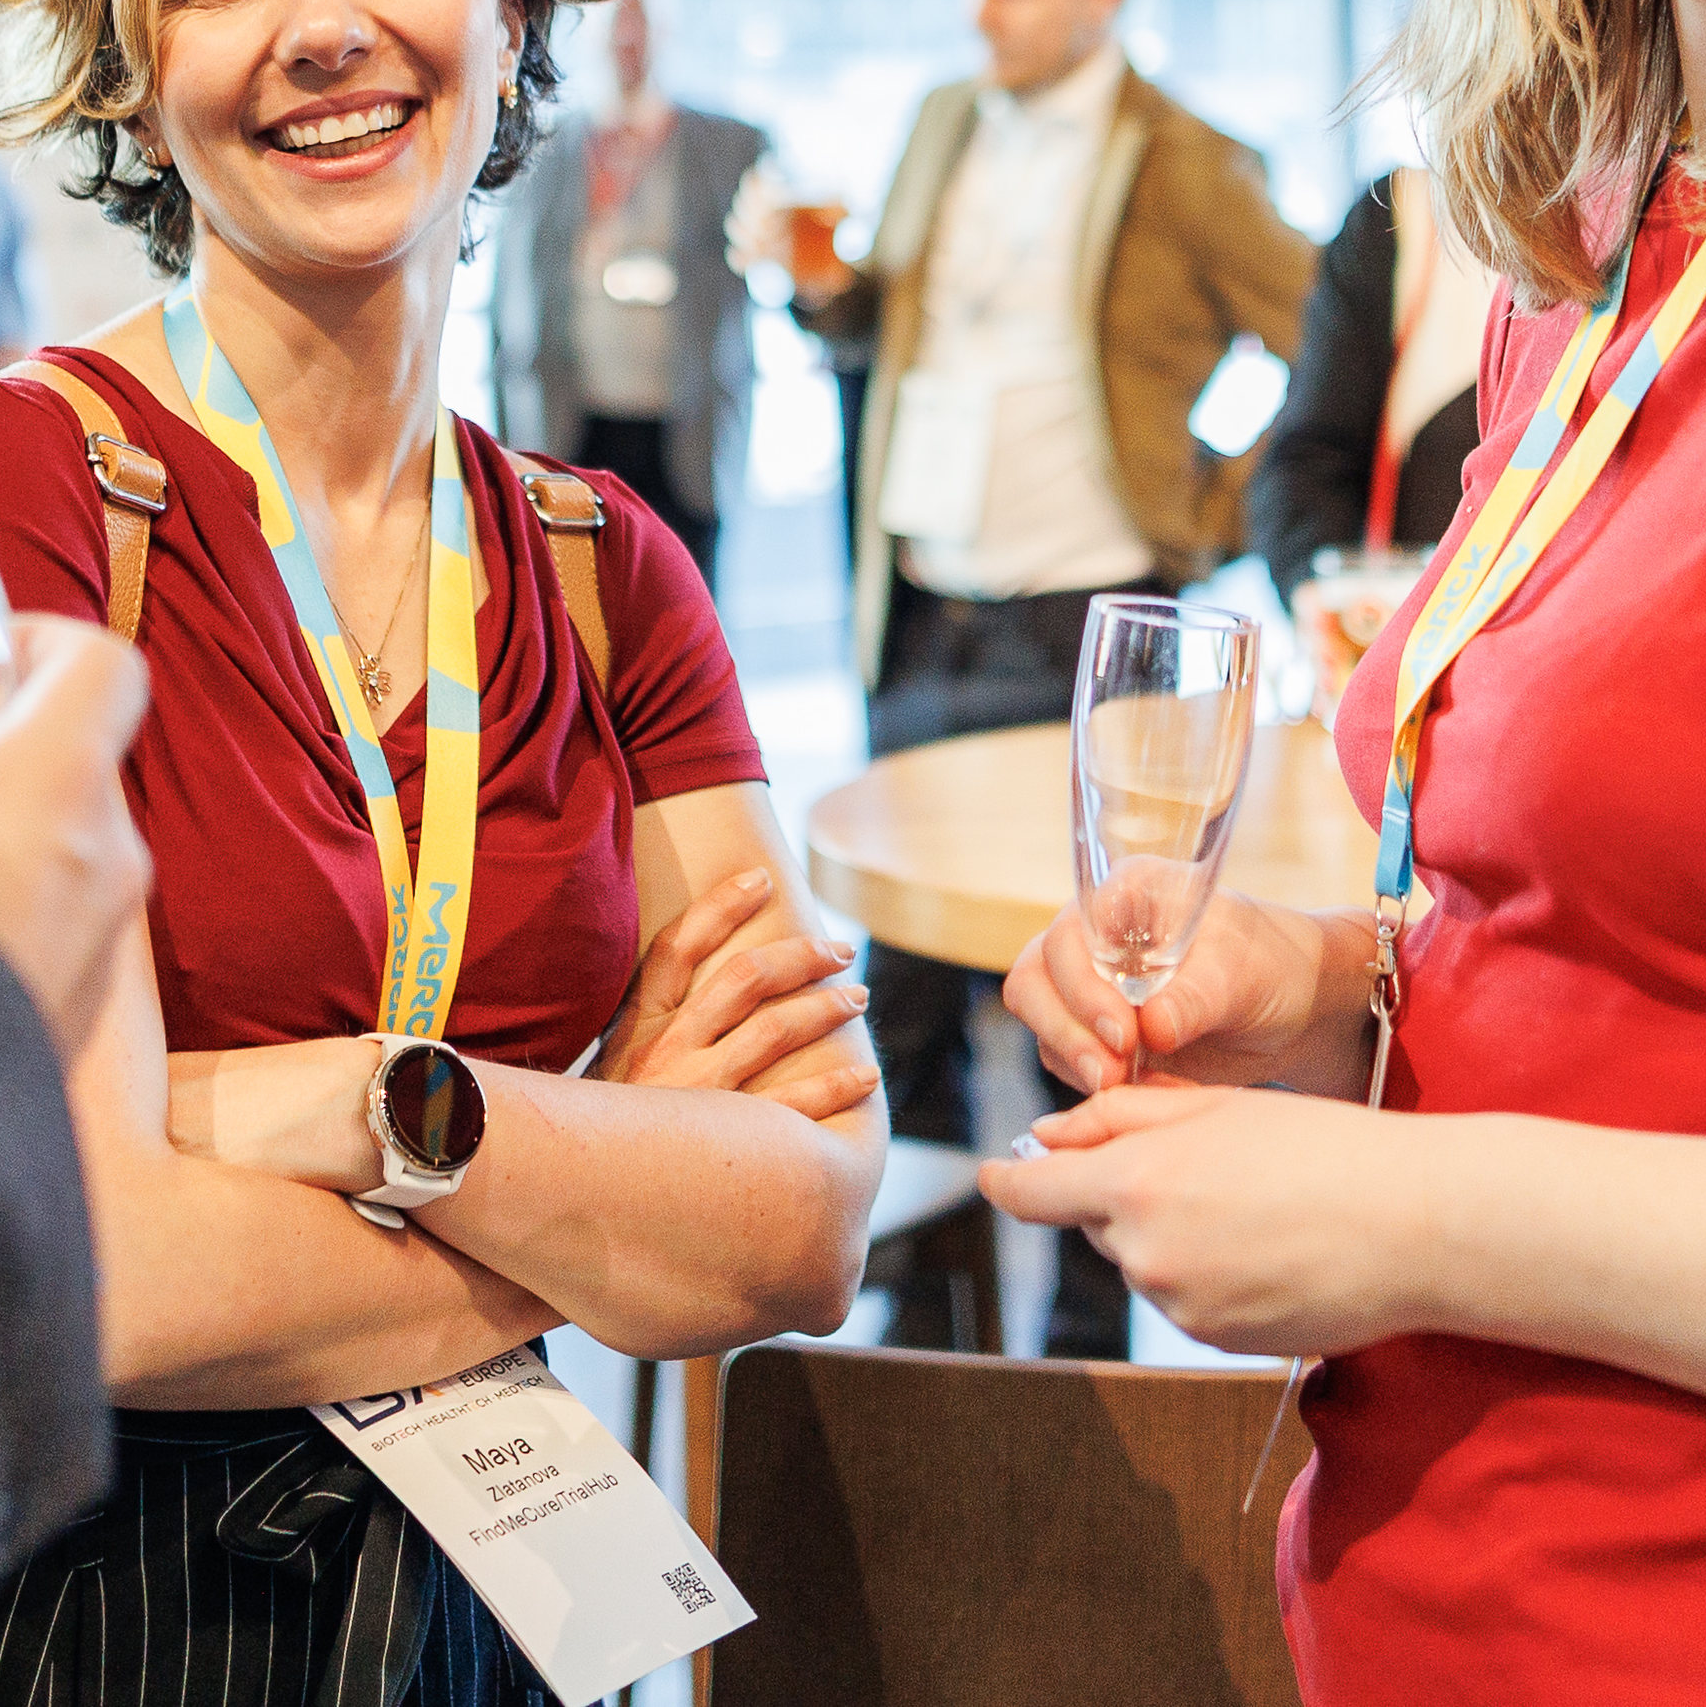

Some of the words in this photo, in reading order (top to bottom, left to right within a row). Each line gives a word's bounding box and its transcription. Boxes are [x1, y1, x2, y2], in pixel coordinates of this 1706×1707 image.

[458, 1353, 527, 1388] EUROPE
[371, 1422, 423, 1453] BIOTECH
[424, 1394, 493, 1427] HEALTHTCH
[493, 1374, 545, 1402] MEDTECH
[462, 1438, 534, 1475] Maya
[486, 1464, 560, 1503] Zlatanova
[468, 1472, 619, 1547] FindMeCure/TrialHub
